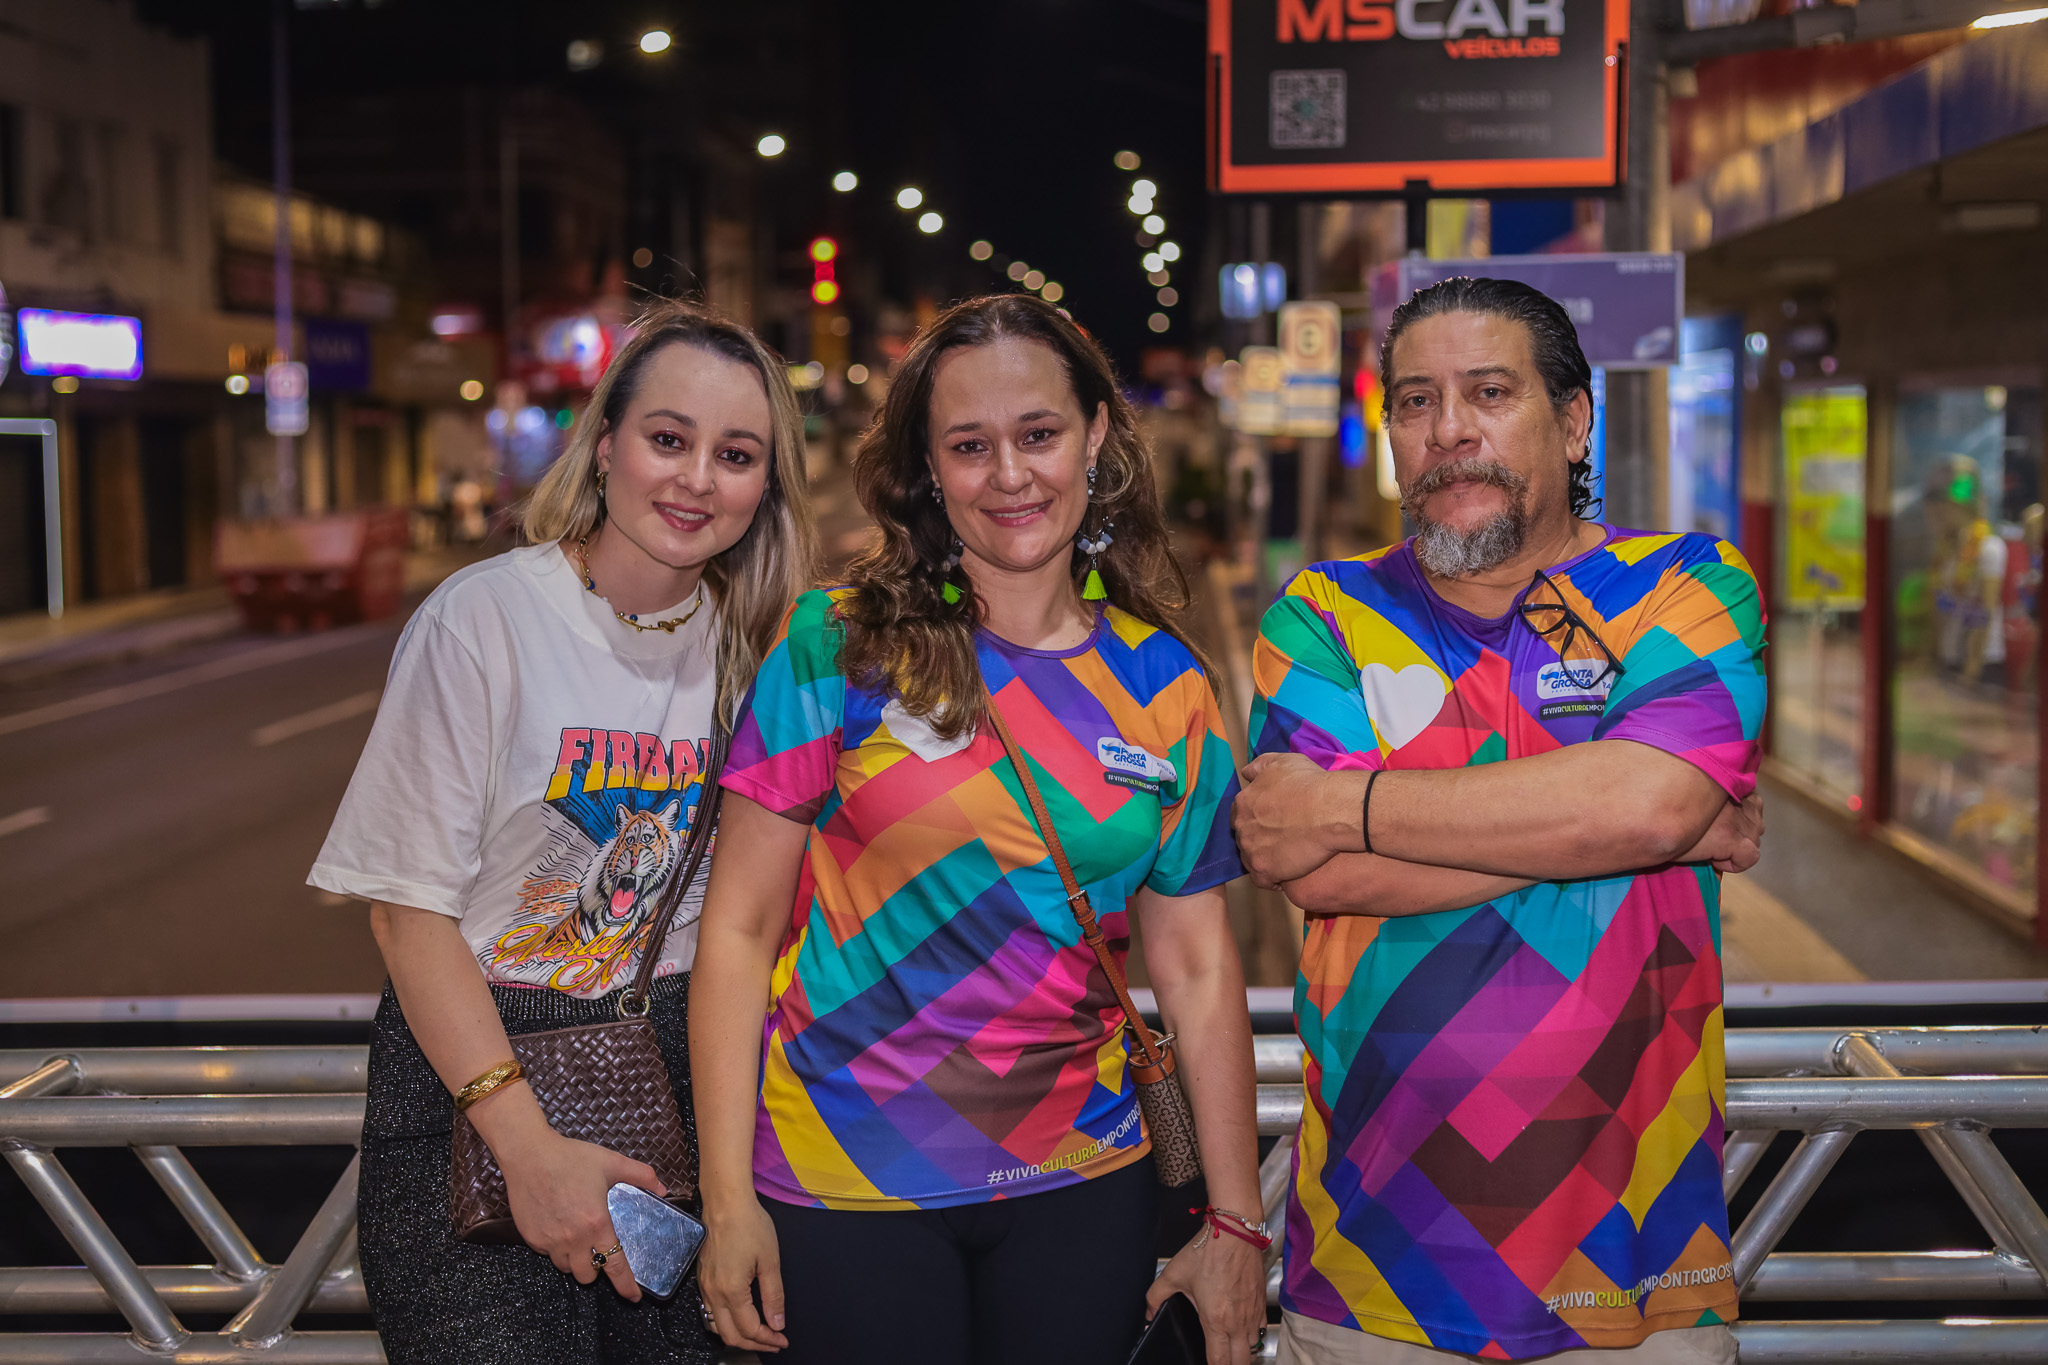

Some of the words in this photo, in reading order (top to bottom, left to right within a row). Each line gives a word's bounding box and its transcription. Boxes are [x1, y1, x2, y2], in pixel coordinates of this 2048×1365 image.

[1277, 0, 1565, 42] MSCAR
[1444, 35, 1561, 59] VEÍCULOS
[1559, 669, 1594, 679] PONTA
